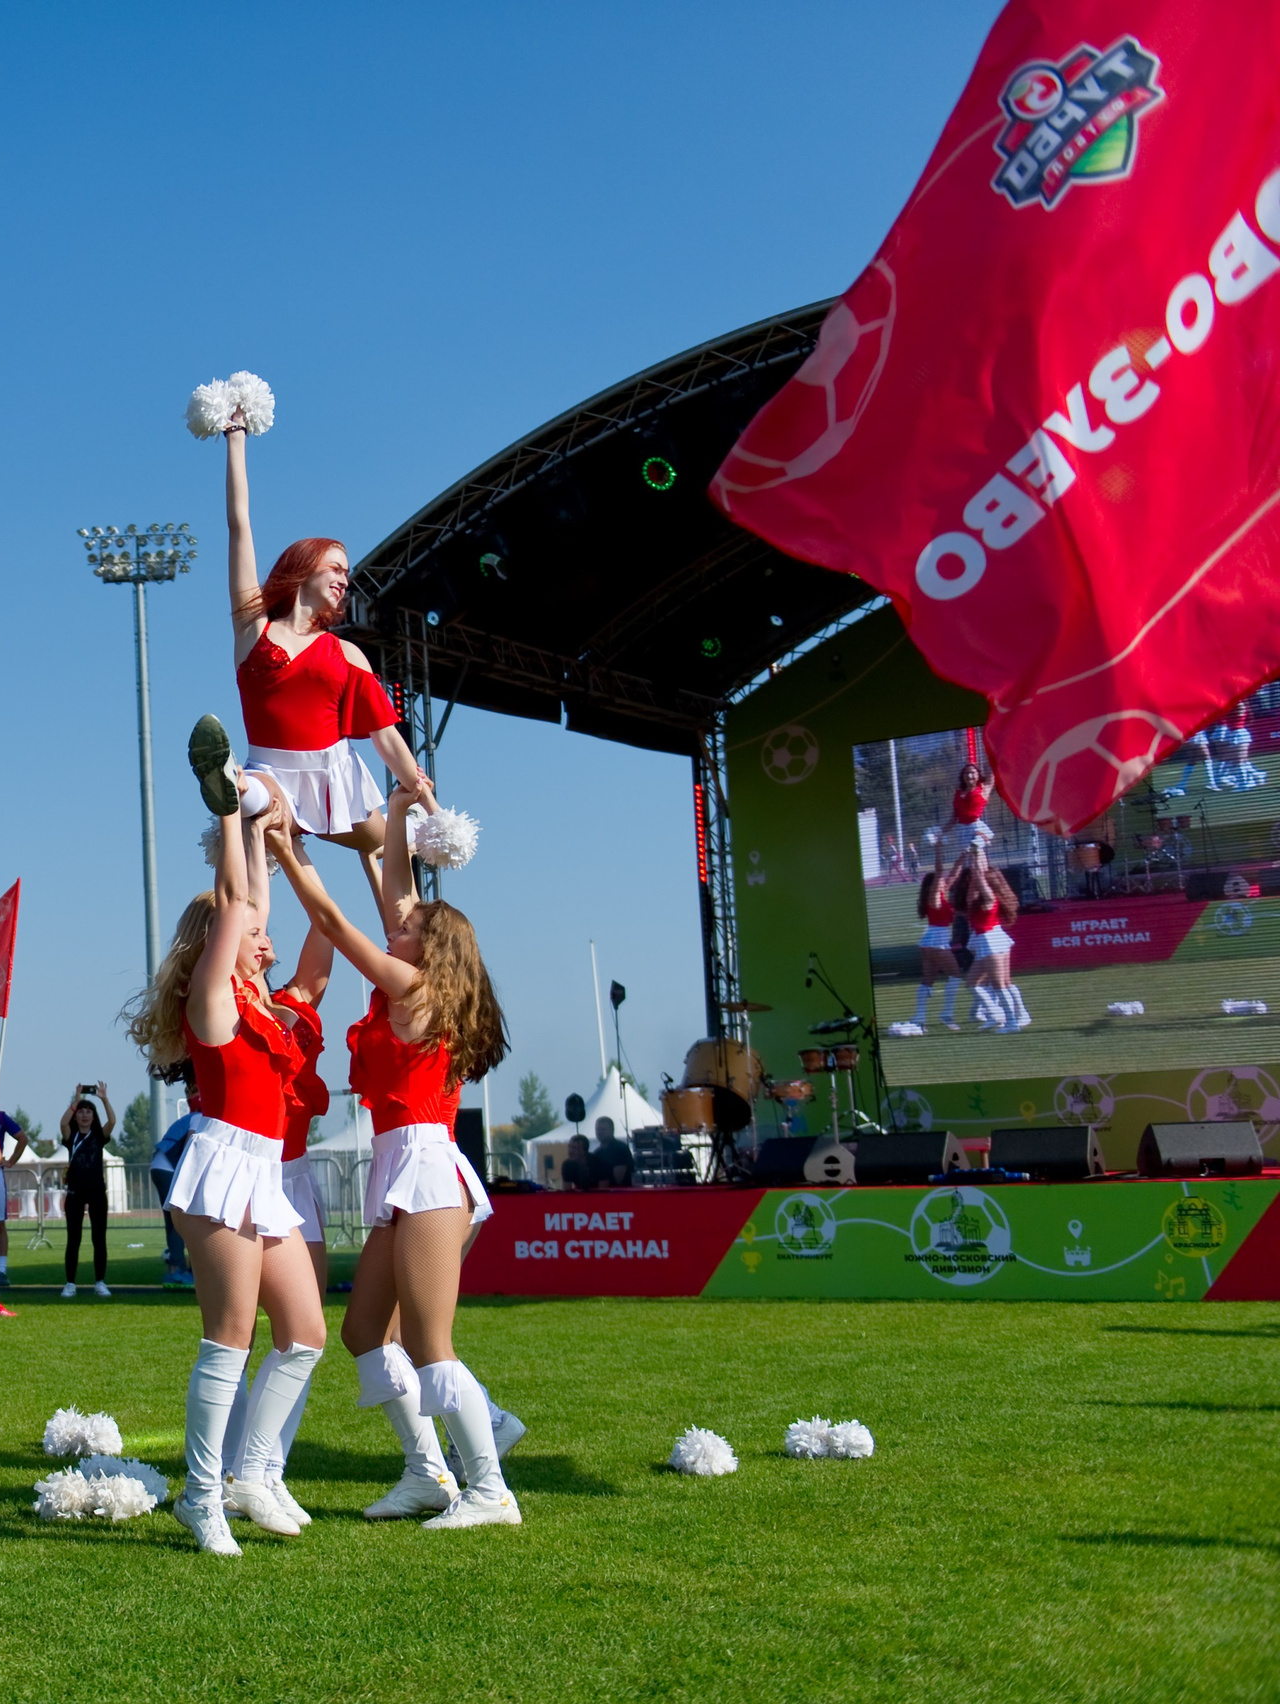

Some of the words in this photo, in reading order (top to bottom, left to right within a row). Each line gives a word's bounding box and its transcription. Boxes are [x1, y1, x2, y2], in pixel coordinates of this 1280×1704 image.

[1070, 917, 1128, 933] ИГРАЕТ
[1051, 936, 1081, 948] ВСЯ
[1084, 932, 1151, 946] СТРАНА!
[544, 1212, 634, 1231] ИГРАЕТ
[514, 1240, 559, 1259] ВСЯ
[564, 1239, 669, 1259] СТРАНА!
[904, 1253, 1017, 1263] ЮЖНО-МОСКОВСКИЙ
[931, 1264, 991, 1274] ДИВИЗИОН
